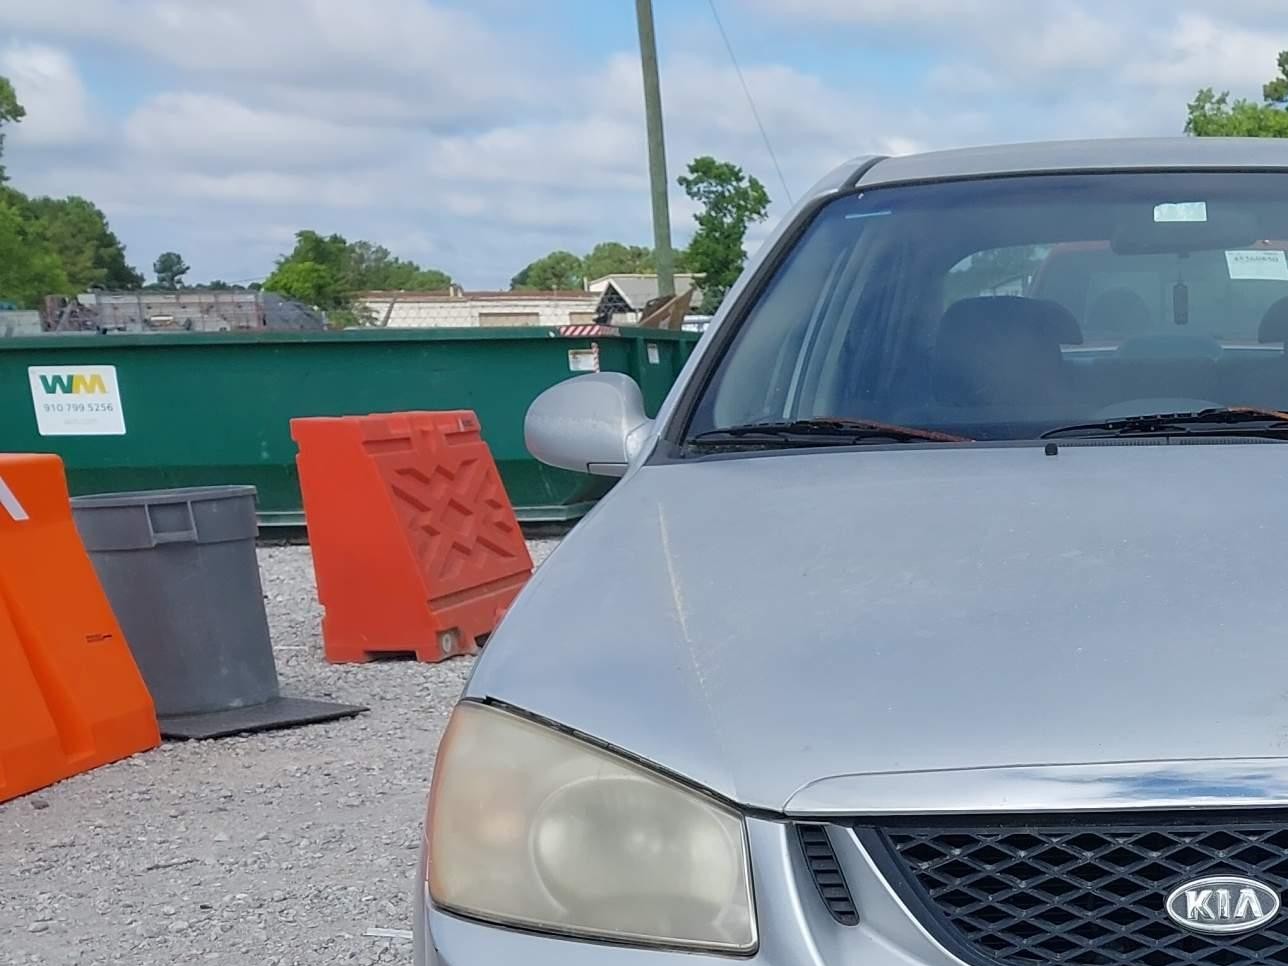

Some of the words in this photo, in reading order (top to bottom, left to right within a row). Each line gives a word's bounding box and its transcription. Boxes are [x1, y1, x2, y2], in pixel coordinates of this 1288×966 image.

[39, 374, 107, 394] WM
[43, 403, 64, 413] 910
[1185, 887, 1264, 921] KIA
